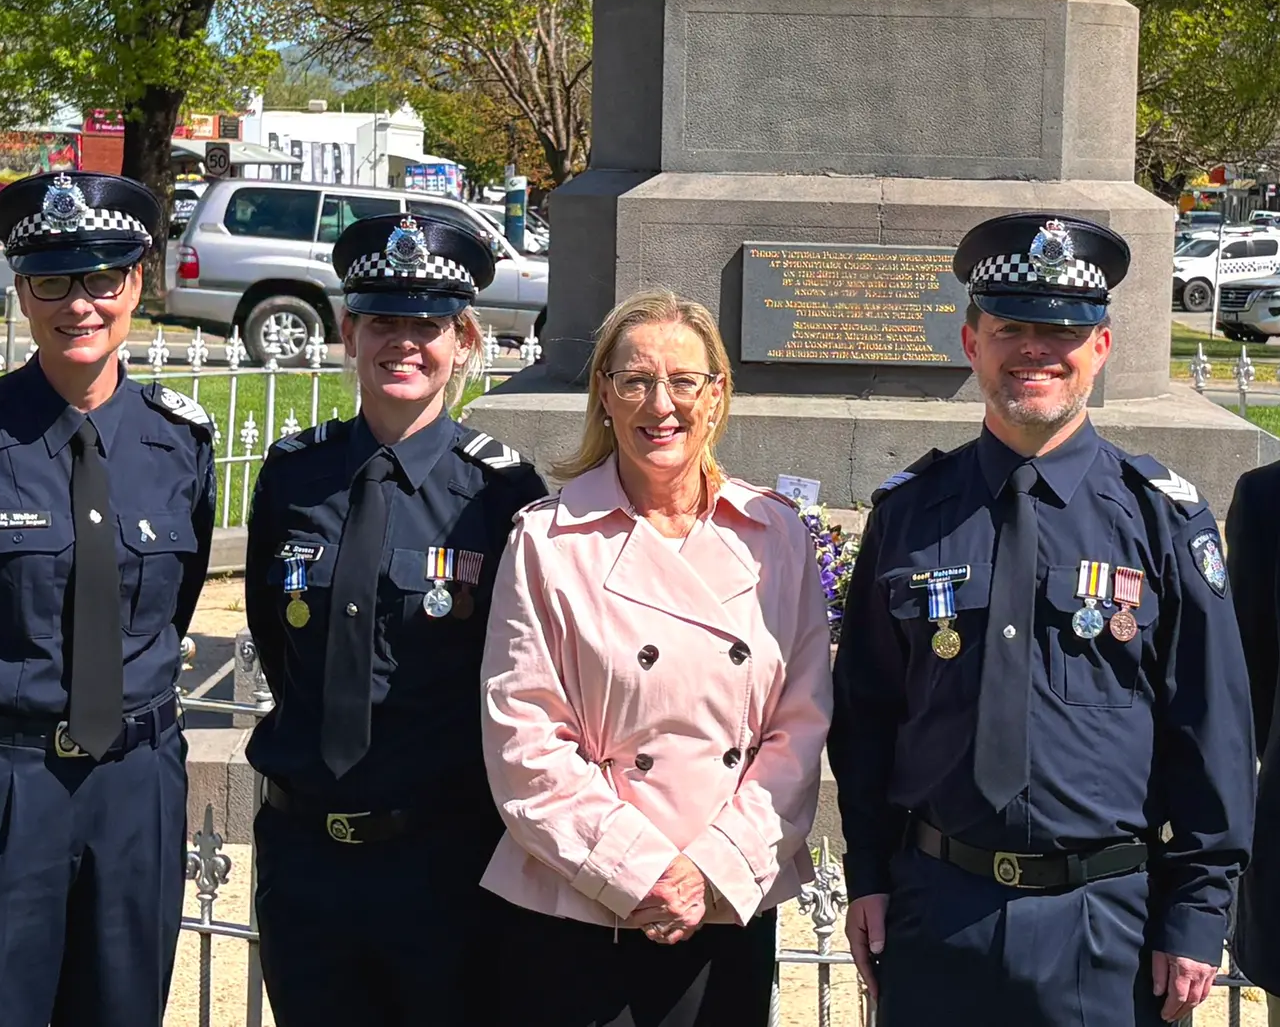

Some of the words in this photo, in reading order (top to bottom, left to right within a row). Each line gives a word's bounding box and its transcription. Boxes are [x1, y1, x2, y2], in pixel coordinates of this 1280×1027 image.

[209, 154, 227, 169] 50
[781, 250, 821, 259] VICTORIA
[912, 572, 931, 581] Geoff
